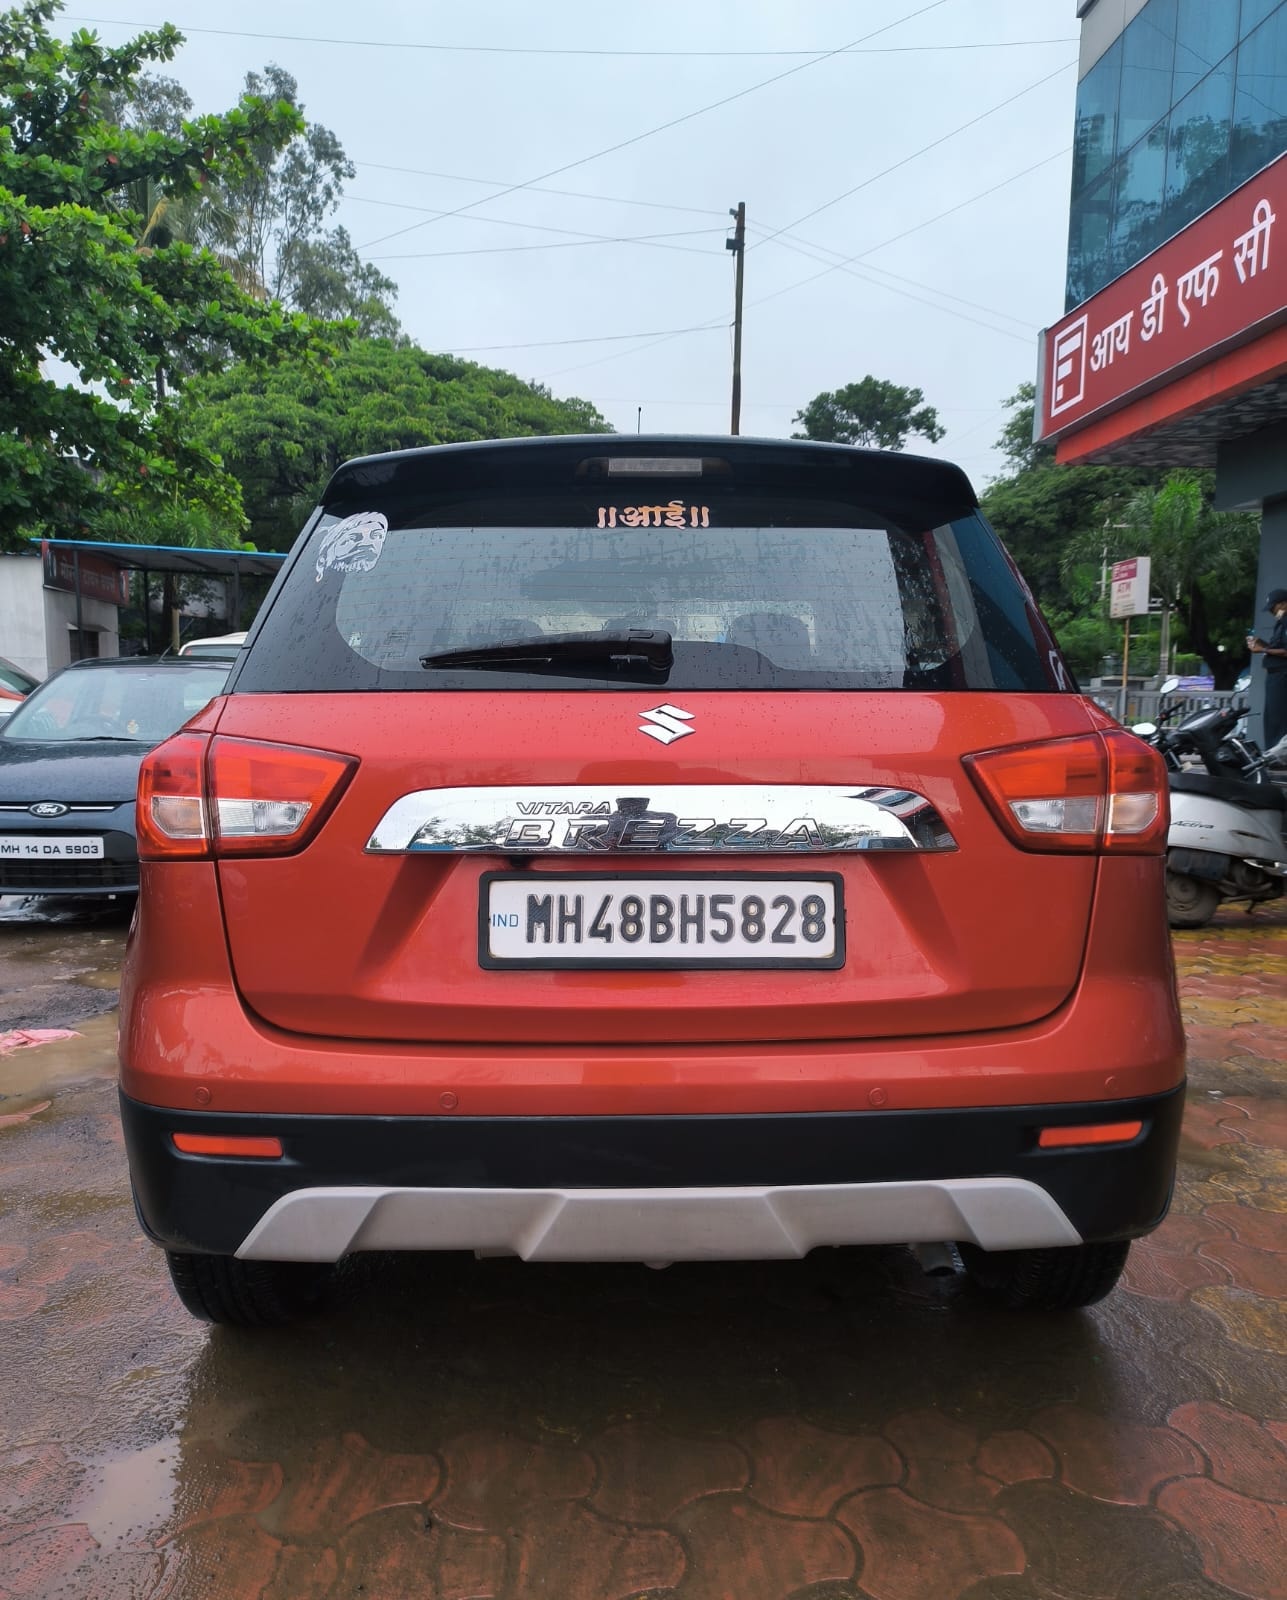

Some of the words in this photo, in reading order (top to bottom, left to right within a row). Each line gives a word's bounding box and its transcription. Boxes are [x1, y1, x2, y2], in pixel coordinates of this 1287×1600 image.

[1090, 311, 1133, 372] आय
[1141, 273, 1168, 342] डी
[1177, 250, 1223, 327] एफ
[1233, 199, 1275, 284] सी
[37, 804, 58, 813] Ford
[516, 801, 612, 815] VITARA
[504, 818, 825, 850] BREZZA
[1, 845, 20, 854] MH
[25, 845, 38, 854] 14
[43, 845, 60, 854] DA
[65, 845, 99, 854] 5903
[492, 914, 519, 928] IND
[526, 894, 826, 943] MH48BH5828
